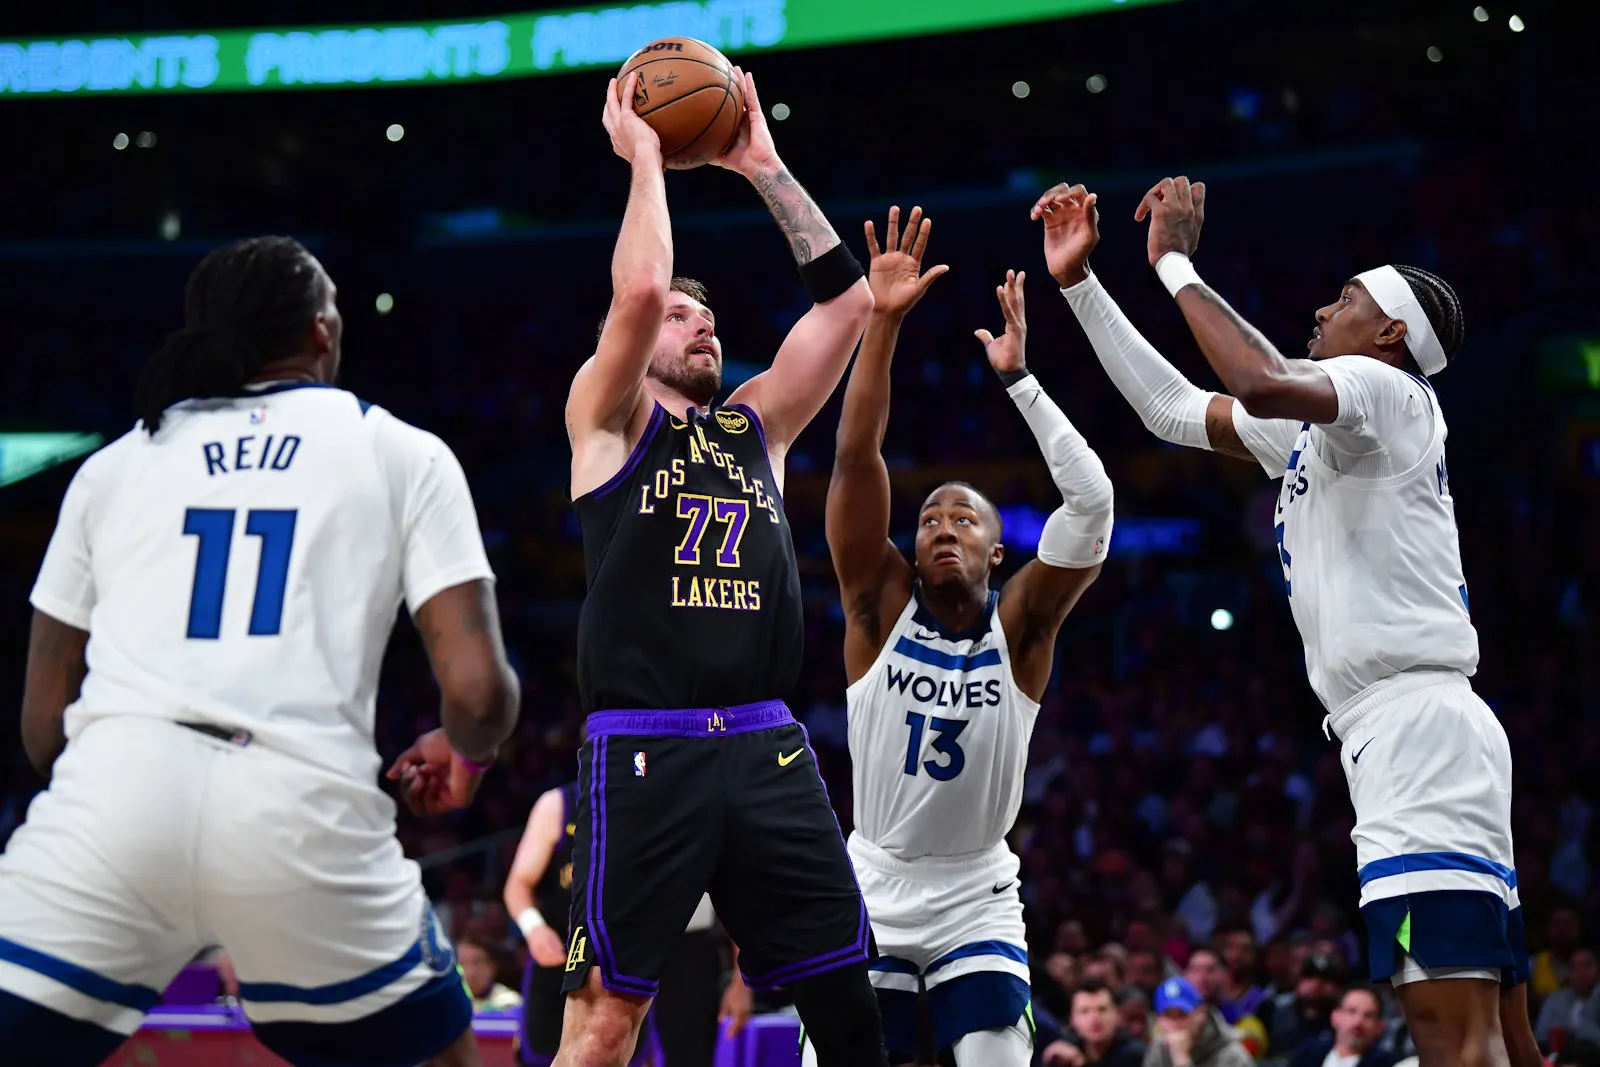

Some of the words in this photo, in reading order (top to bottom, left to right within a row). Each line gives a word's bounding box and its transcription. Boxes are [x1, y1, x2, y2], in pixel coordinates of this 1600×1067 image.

[203, 434, 302, 477] REID
[638, 458, 686, 515] LOS
[688, 424, 780, 525] ANGELES
[674, 493, 750, 567] 77
[181, 506, 299, 640] 11
[670, 575, 761, 612] LAKERS
[886, 663, 1001, 709] WOLVES
[903, 710, 970, 782] 13
